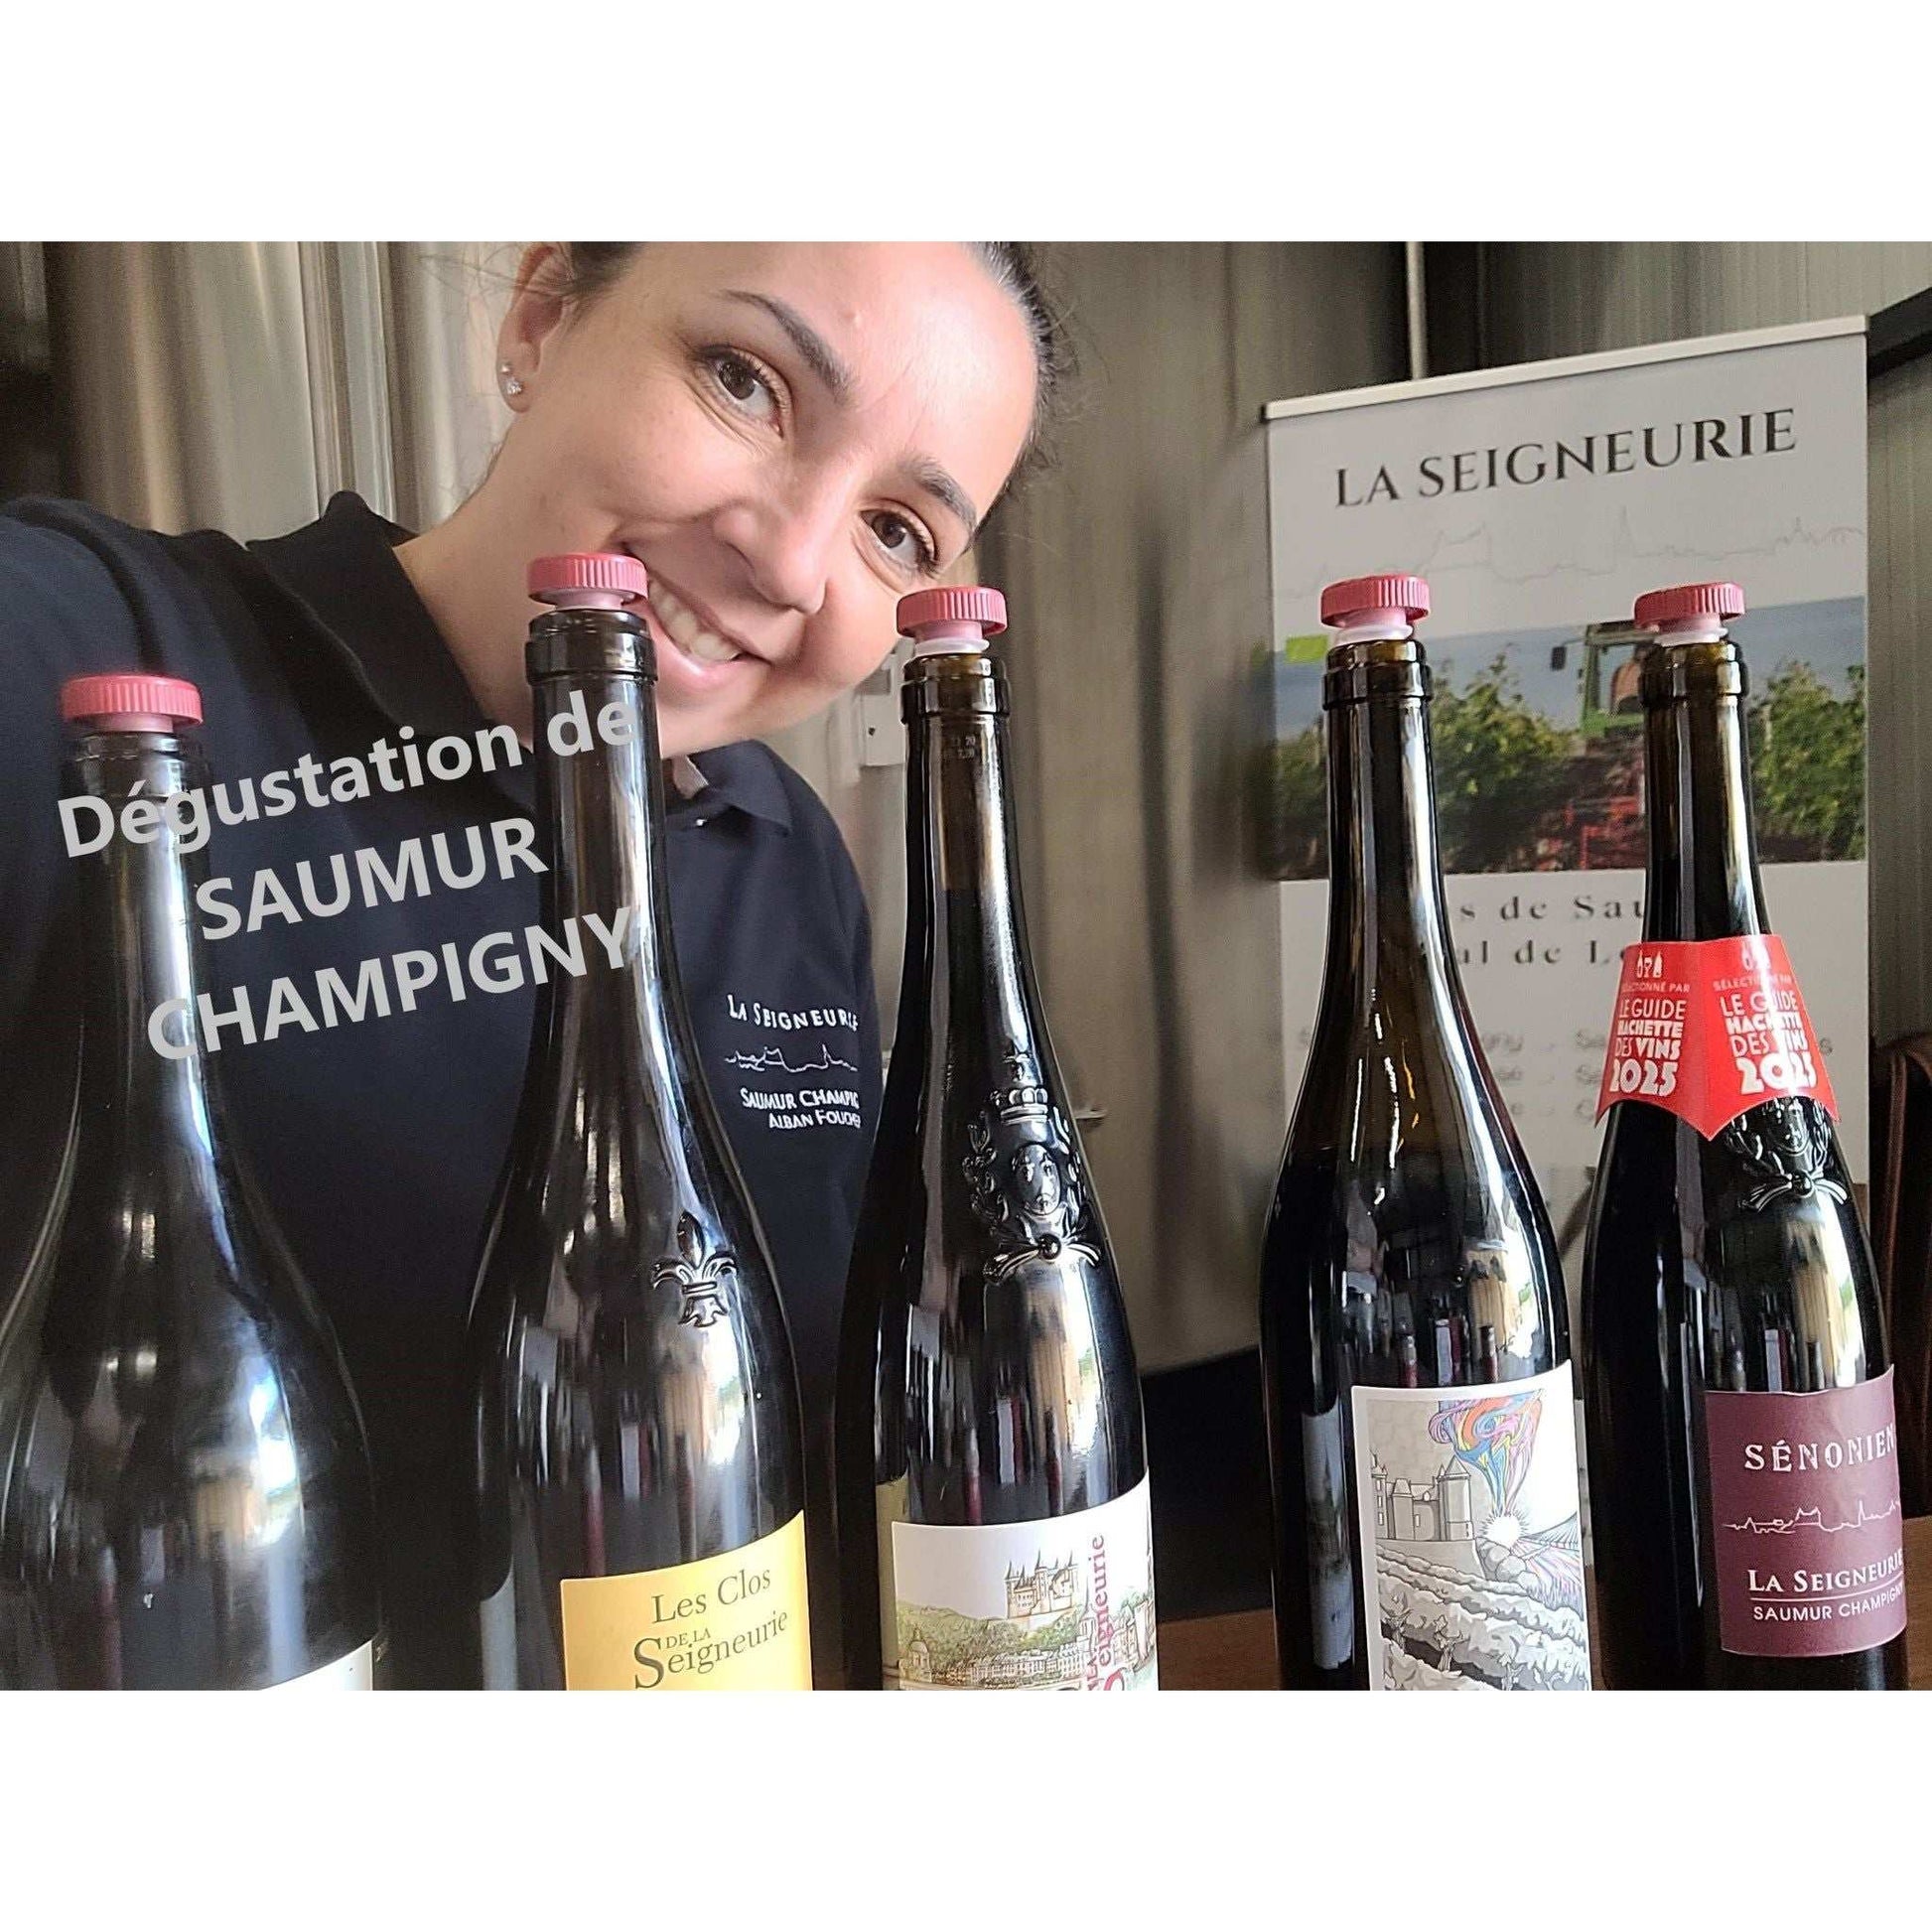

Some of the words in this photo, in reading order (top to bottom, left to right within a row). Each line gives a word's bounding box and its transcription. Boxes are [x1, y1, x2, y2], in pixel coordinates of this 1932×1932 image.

[1335, 464, 1401, 507] LA
[1418, 408, 1798, 499] SEIGNEURIE
[1500, 896, 1547, 921] de
[1515, 938, 1561, 964] de
[727, 994, 748, 1022] LA
[1631, 998, 1687, 1021] GUIDE
[1720, 993, 1744, 1018] LE
[1616, 1019, 1684, 1038] HACHETTE
[1614, 1036, 1632, 1058] DES
[1636, 1036, 1682, 1060] VINS
[1729, 1032, 1771, 1058] DES
[1608, 1057, 1679, 1098] 2025
[1735, 1049, 1818, 1095] 2025
[740, 1087, 797, 1111] SAUMUR
[768, 1112, 813, 1130] ALBAN
[1747, 1569, 1785, 1593] LA
[651, 1592, 708, 1624] Les
[717, 1568, 772, 1606] Clos
[1753, 1604, 1833, 1622] SAUMUR
[633, 1610, 789, 1690] Seigneurie
[665, 1632, 689, 1650] DE
[692, 1627, 711, 1642] LA
